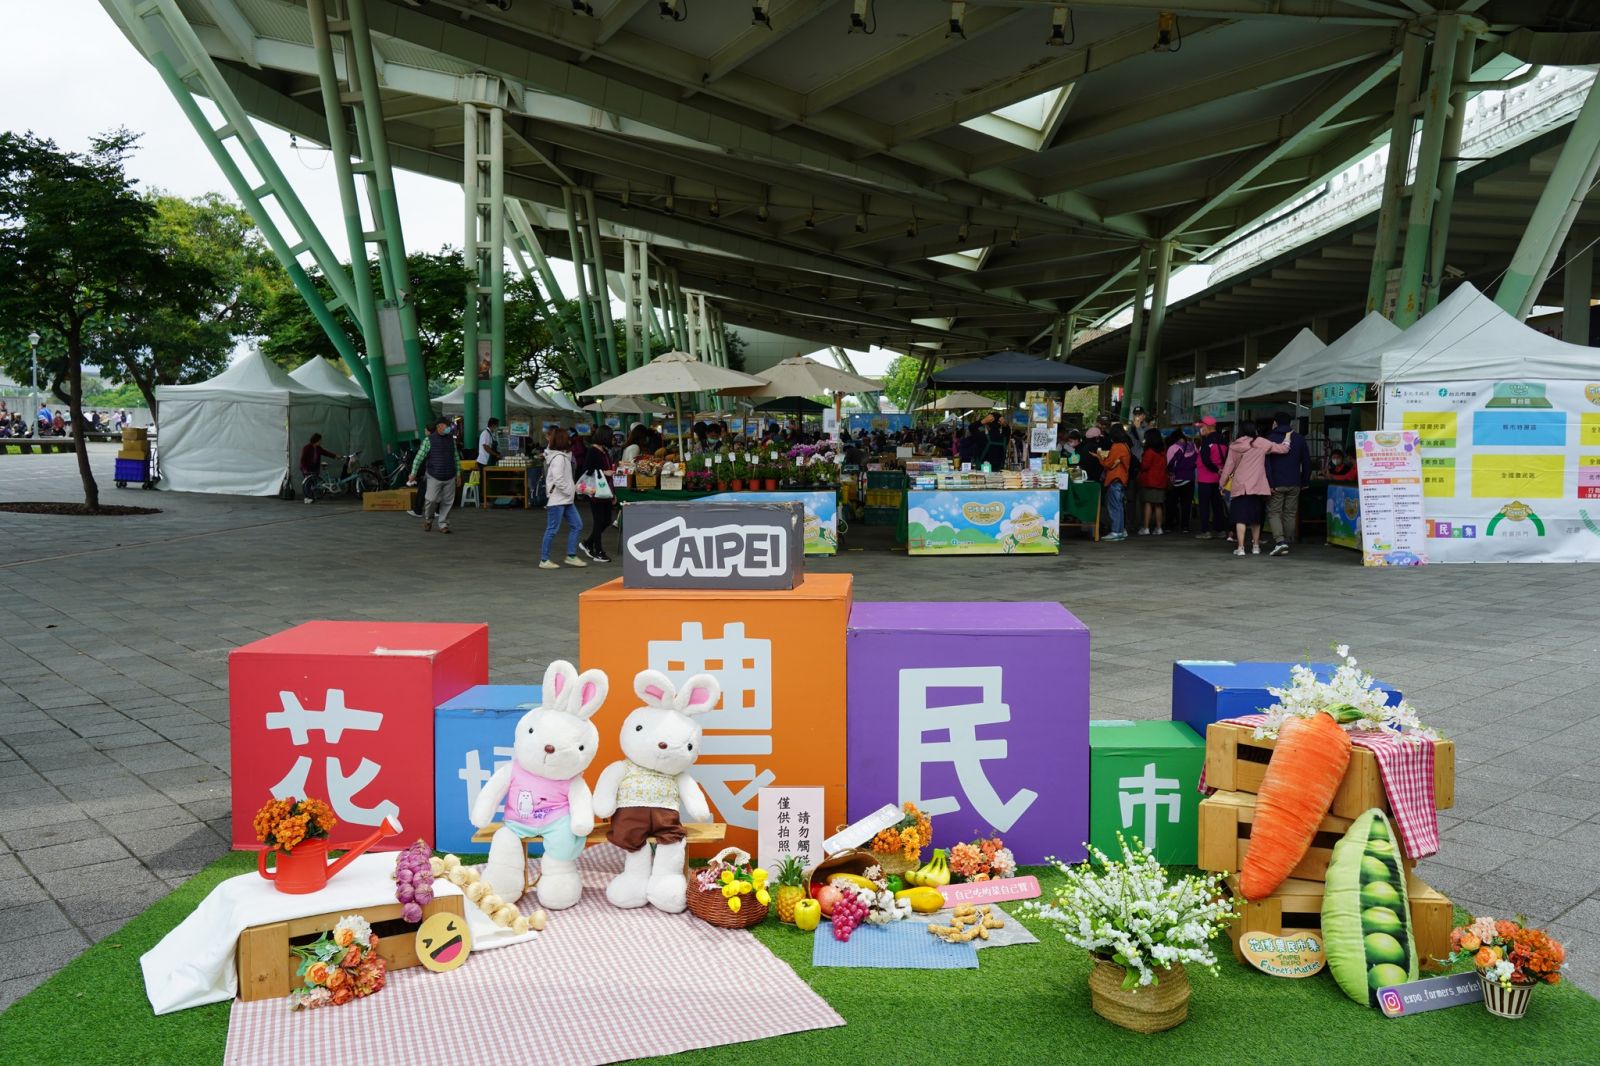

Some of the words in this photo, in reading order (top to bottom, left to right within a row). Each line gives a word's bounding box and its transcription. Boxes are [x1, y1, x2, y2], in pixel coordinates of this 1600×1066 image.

[628, 517, 786, 576] TAIPEI
[265, 688, 399, 826] 花
[898, 666, 1038, 833] 民
[777, 796, 791, 853] 僅供拍照
[1119, 763, 1181, 850] 市
[1248, 937, 1321, 953] 花博農民市集
